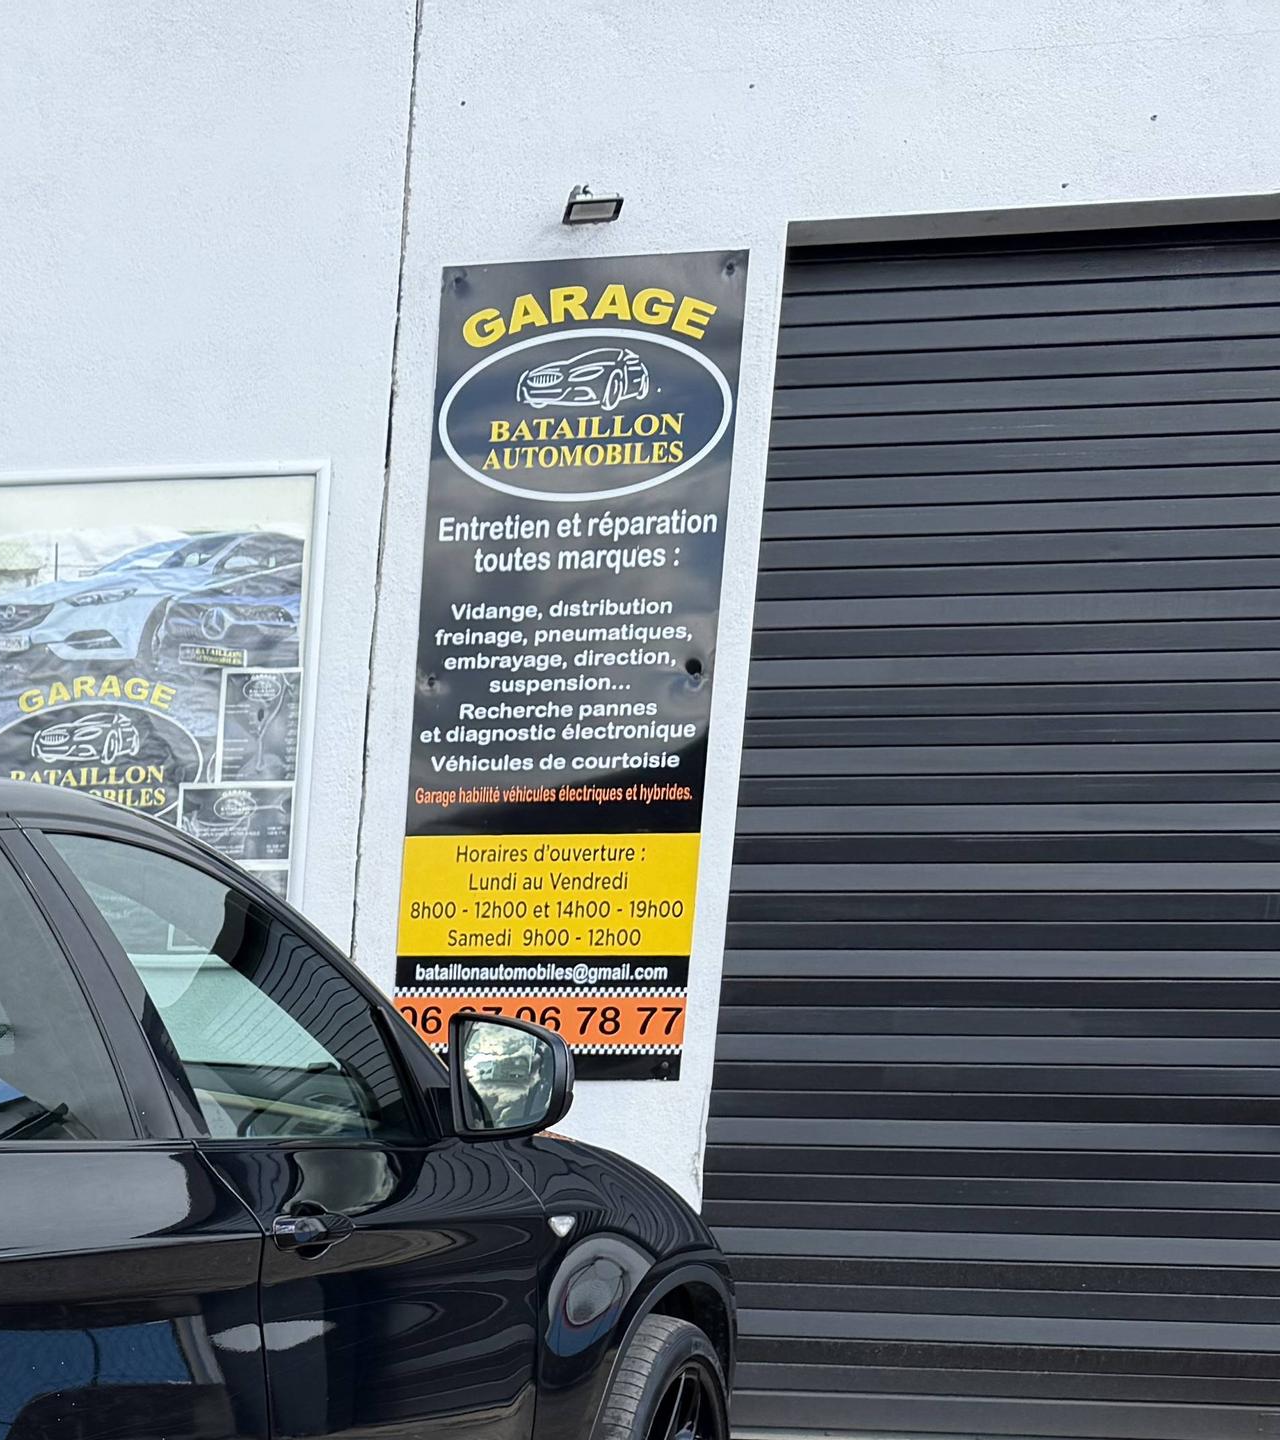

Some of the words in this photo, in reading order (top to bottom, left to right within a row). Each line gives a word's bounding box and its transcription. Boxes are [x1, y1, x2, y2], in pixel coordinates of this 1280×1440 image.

[462, 284, 717, 348] GARAGE
[489, 412, 685, 443] BATAILLON
[482, 441, 684, 470] AUTOMOBILES
[439, 515, 551, 543] Entretien
[556, 516, 582, 538] et
[588, 509, 718, 541] réparation
[474, 548, 551, 573] toutes
[558, 546, 665, 574] marques
[451, 603, 543, 622] Vidange,
[549, 598, 673, 617] distribution
[434, 629, 529, 648] freinage,
[533, 624, 694, 646] pneumatiques,
[443, 653, 568, 672] embrayage,
[574, 649, 677, 668] direction,
[18, 675, 177, 713] GARAGE
[489, 674, 631, 695] suspension...
[459, 702, 573, 720] Recherche
[579, 702, 658, 720] pannes
[419, 726, 441, 743] et
[446, 725, 556, 745] diagnostic
[561, 721, 697, 742] électronique
[431, 754, 534, 771] Véhicules
[539, 754, 566, 770] de
[571, 752, 680, 769] courtoisie
[415, 787, 456, 807] Garage
[458, 785, 500, 803] habilité
[503, 785, 557, 802] véhicules
[558, 784, 624, 805] électriques
[625, 786, 638, 800] et
[639, 783, 694, 804] hybrides.
[456, 846, 528, 863] Horaires
[534, 844, 636, 862] d'ouverture
[469, 872, 517, 891] Lundi
[522, 876, 543, 890] au
[549, 871, 629, 890] Vendredi
[410, 900, 457, 919] 8h00
[474, 901, 527, 919] 12h00
[533, 903, 550, 918] et
[557, 900, 612, 918] 14h00
[629, 900, 684, 918] 19h00
[447, 928, 512, 947] Samedi
[522, 929, 570, 947] 9h00
[588, 928, 641, 946] 12h00
[415, 962, 669, 984] bataillonautomobiles@gmail.com
[576, 1006, 621, 1035] 78
[636, 1006, 683, 1035] 77
